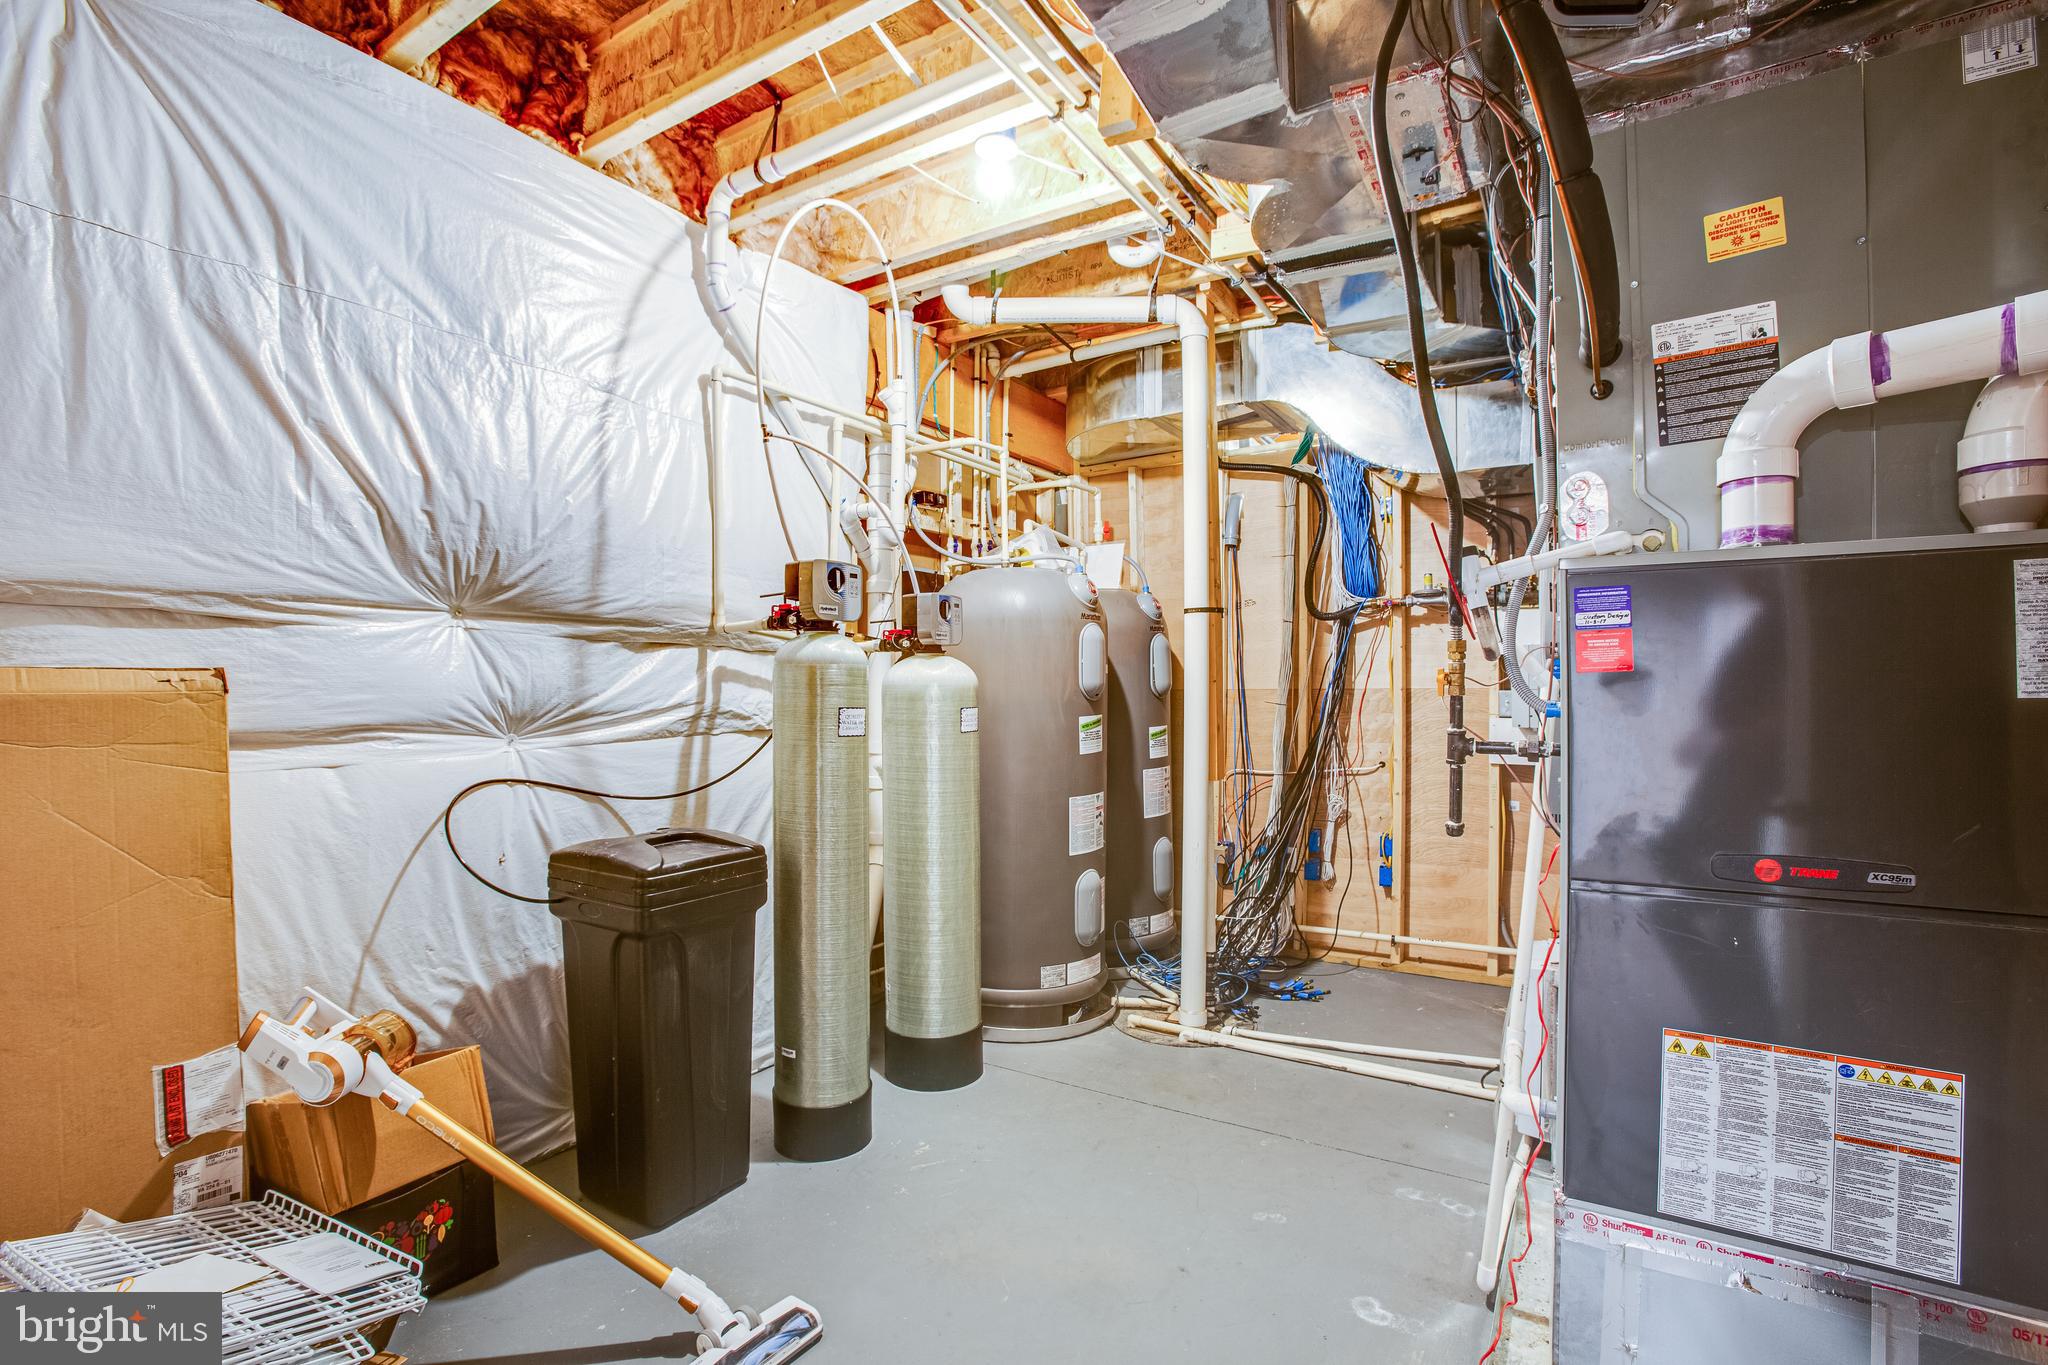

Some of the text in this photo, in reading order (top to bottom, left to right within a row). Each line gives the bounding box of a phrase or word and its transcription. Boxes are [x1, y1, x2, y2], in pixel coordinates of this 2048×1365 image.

[1730, 73, 1760, 87] 181A-P
[1769, 60, 1806, 77] 181B-FX
[1720, 204, 1766, 222] CAUTION
[1708, 214, 1780, 237] DISCONNECT POWER
[1726, 217, 1746, 226] LIGHT
[1710, 220, 1779, 241] BEFORE SERVICING
[1674, 351, 1704, 360] WARNING
[1714, 339, 1768, 354] AVERTISSEMENT
[1790, 866, 1840, 880] TRANE
[1871, 873, 1913, 884] XC95m
[1680, 1032, 1704, 1041] WARNING
[1724, 1039, 1771, 1050] AVERTISSEMENT
[1786, 1049, 1828, 1060] ADVERTENCIA
[1886, 1064, 1916, 1074] WARNING
[1909, 1149, 1956, 1162] ADVERTENCIA
[1934, 1302, 1952, 1314] 100
